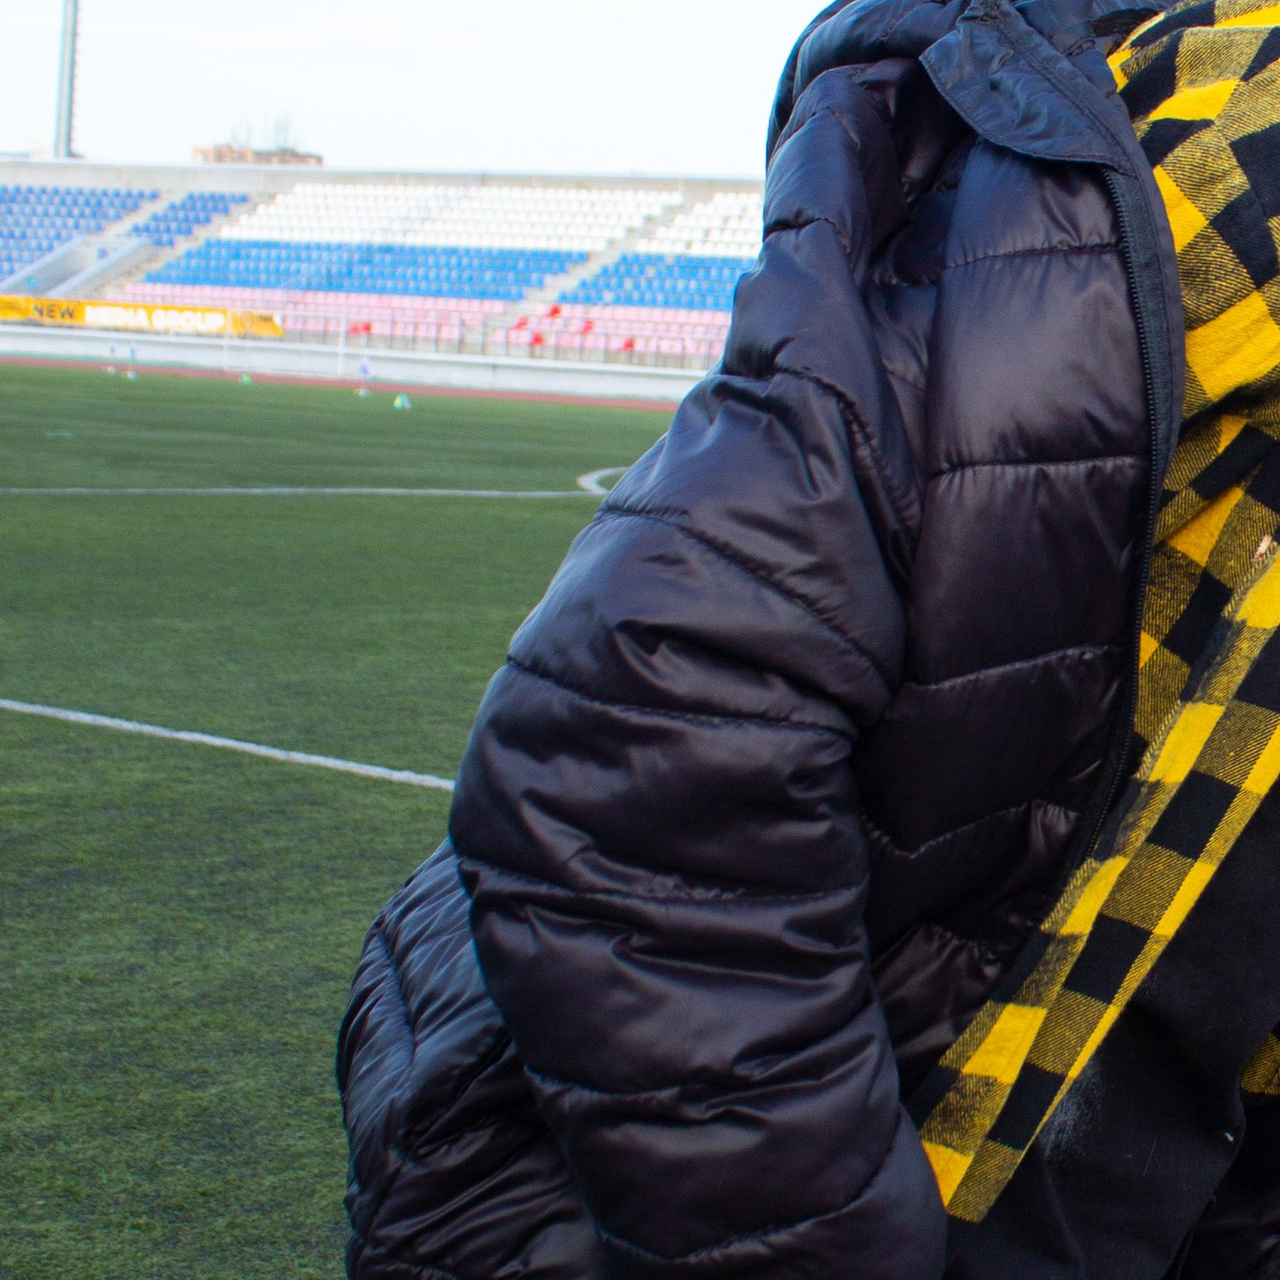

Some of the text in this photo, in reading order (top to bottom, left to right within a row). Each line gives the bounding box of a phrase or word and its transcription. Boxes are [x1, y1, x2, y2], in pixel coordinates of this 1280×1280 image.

[33, 303, 76, 320] NEW
[84, 305, 150, 328] MEDIA
[152, 310, 226, 332] GROUP
